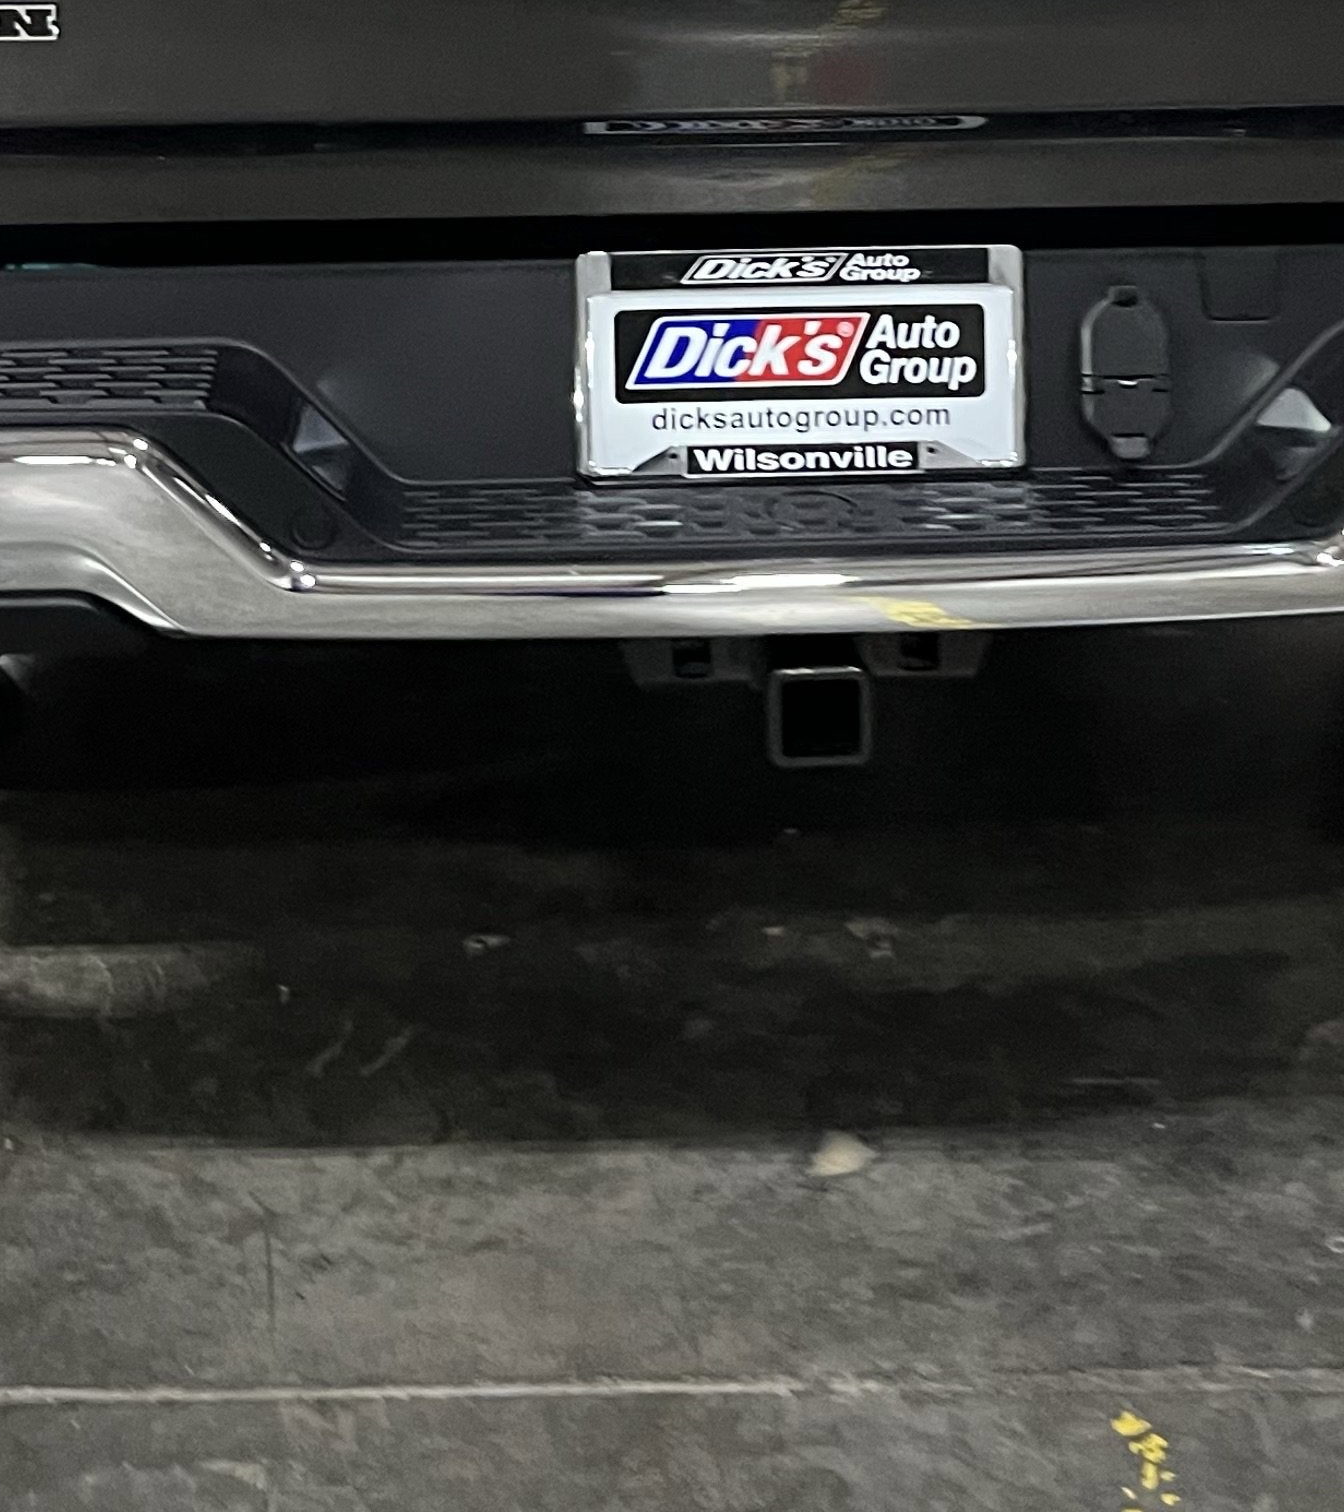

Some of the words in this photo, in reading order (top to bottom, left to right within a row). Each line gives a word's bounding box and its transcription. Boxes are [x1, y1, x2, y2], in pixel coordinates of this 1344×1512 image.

[693, 255, 832, 282] Dick's
[843, 253, 910, 268] Auto
[839, 265, 922, 283] Group
[644, 320, 844, 381] Dick's
[865, 314, 961, 349] Auto
[858, 349, 977, 391] Group
[651, 405, 951, 433] dicksautogroup.com
[693, 444, 913, 473] Wilsonville
